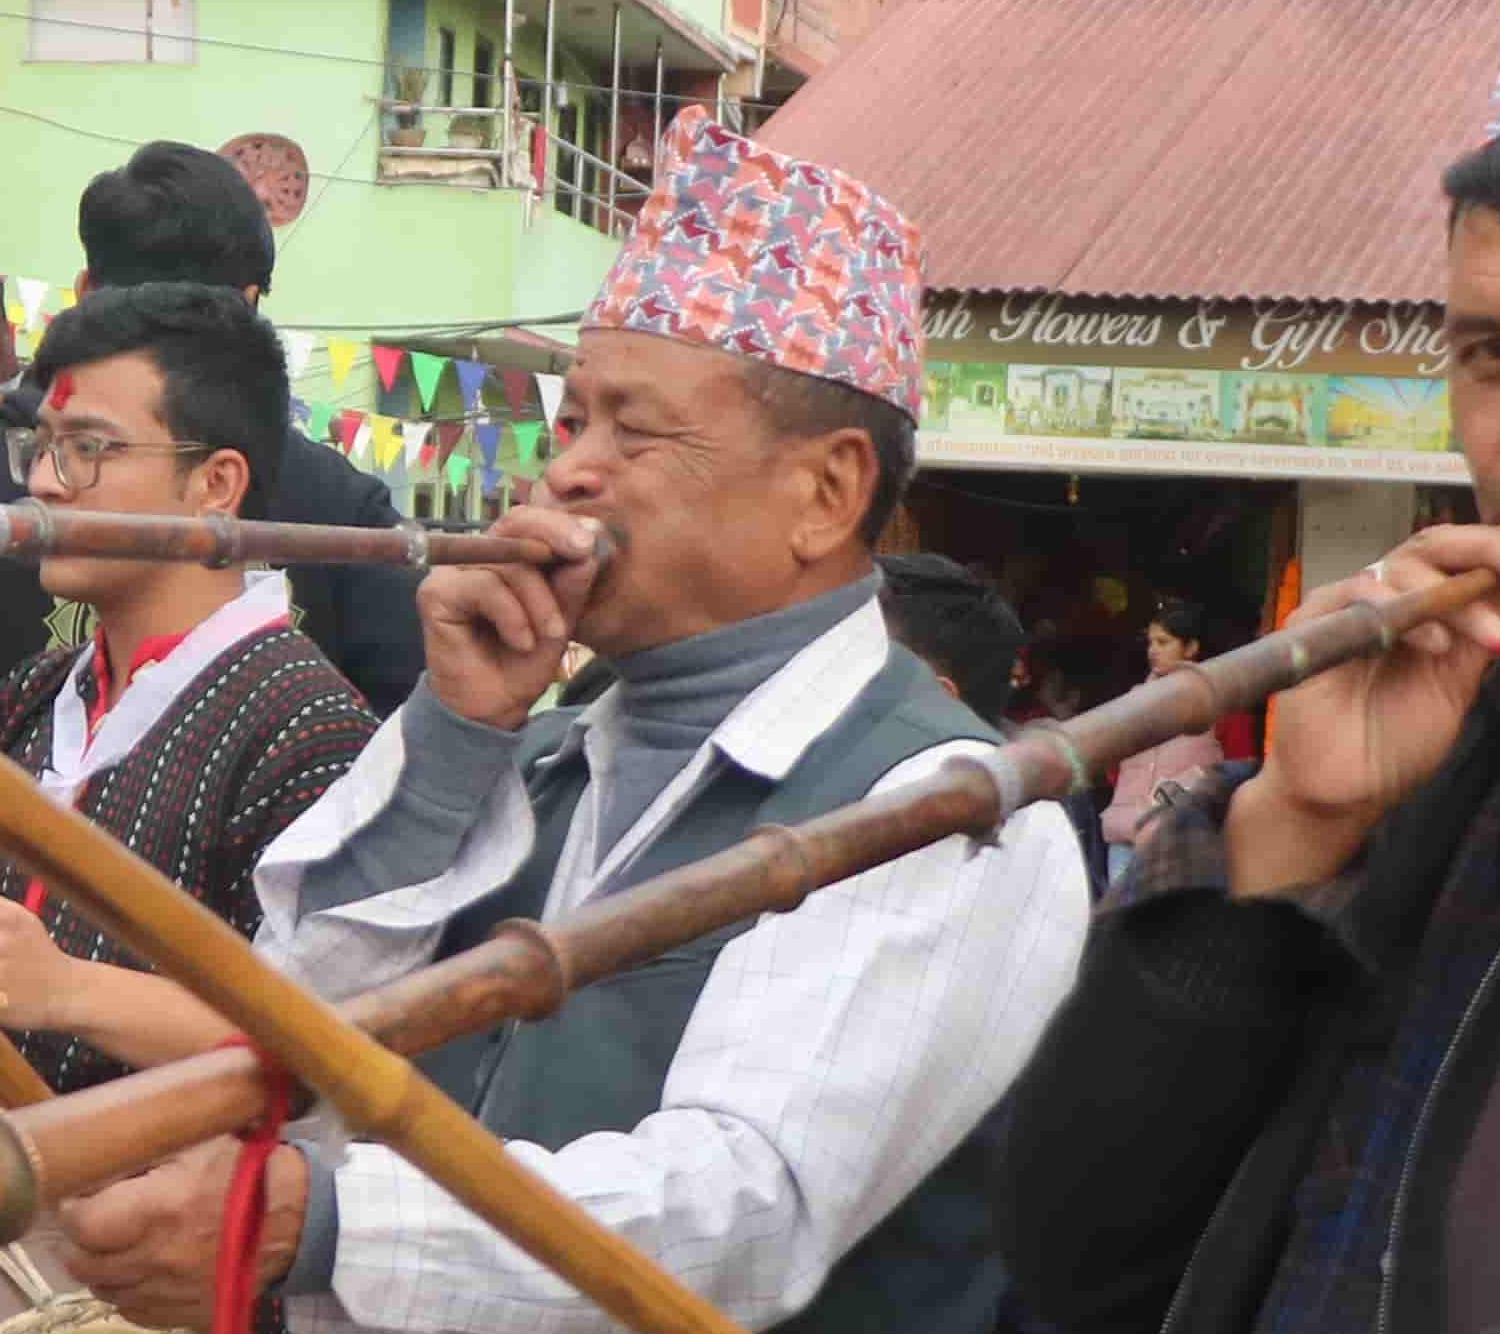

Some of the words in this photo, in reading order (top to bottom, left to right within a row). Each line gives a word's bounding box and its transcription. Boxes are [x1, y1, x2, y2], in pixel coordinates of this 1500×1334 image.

[989, 293, 1162, 346] Flowers
[1177, 299, 1225, 350] &
[1240, 301, 1352, 371] Gift
[1359, 303, 1452, 375] Sho
